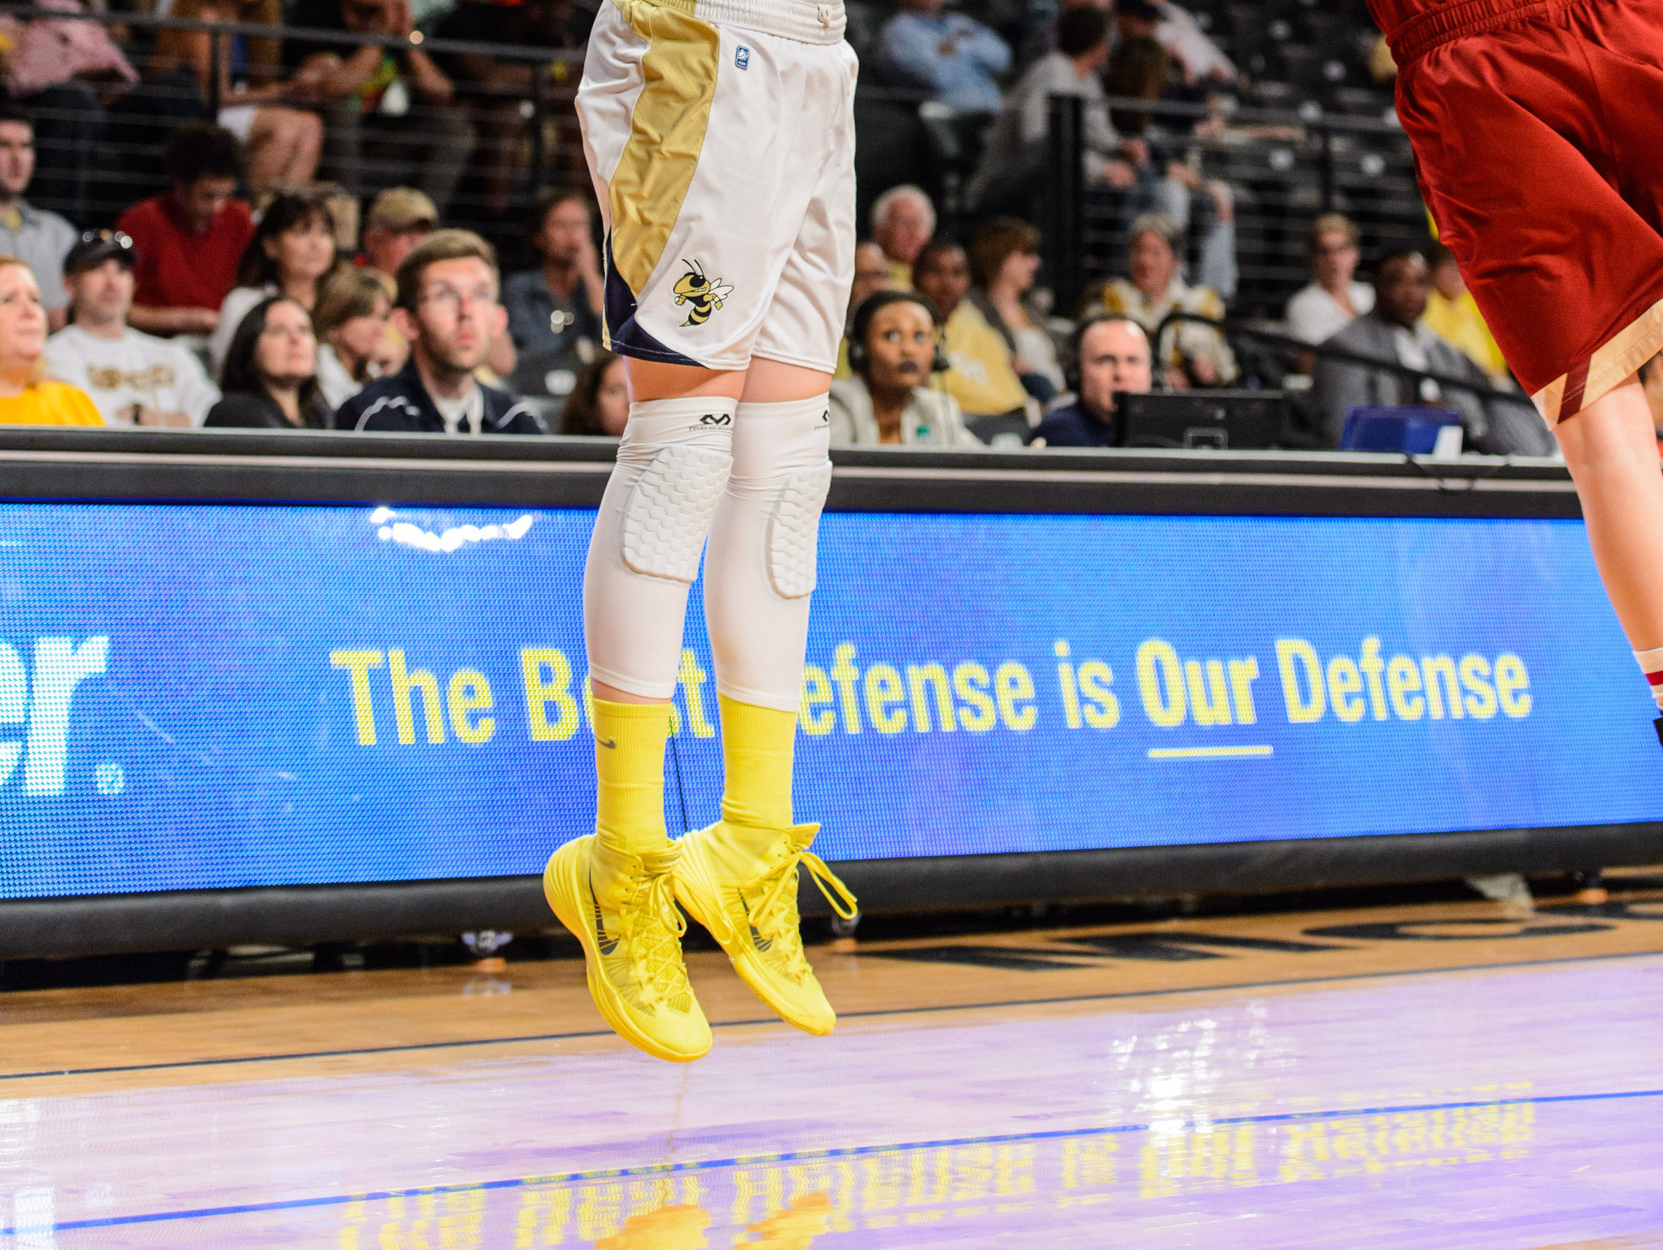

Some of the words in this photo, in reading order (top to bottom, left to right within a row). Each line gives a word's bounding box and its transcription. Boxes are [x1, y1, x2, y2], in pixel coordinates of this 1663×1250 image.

[331, 647, 496, 746] The
[520, 645, 716, 742] Bt
[798, 640, 1038, 737] efense
[1054, 639, 1121, 730] is
[1136, 637, 1260, 728] Our
[1275, 635, 1533, 724] Defense
